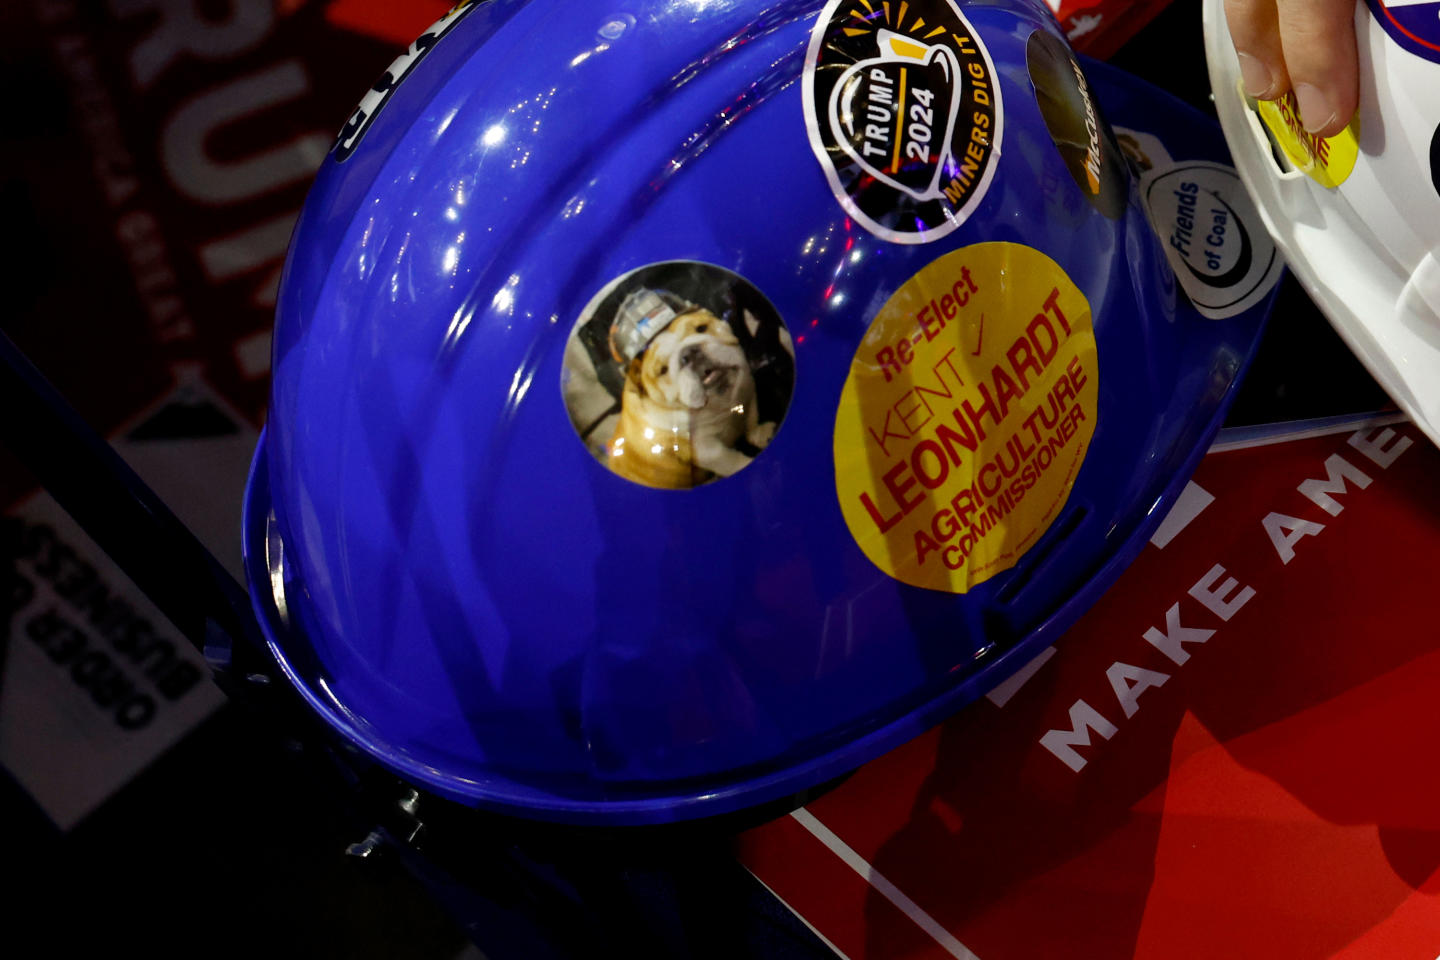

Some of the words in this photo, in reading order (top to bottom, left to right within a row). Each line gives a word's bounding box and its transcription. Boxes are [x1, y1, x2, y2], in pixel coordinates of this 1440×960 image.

[952, 33, 977, 55] IT
[968, 61, 991, 107] DIG
[863, 68, 895, 158] TRUMP
[906, 86, 935, 164] 2024
[944, 111, 991, 206] MINERS
[1169, 181, 1198, 258] Friends
[1206, 208, 1228, 247] Coal
[1206, 251, 1222, 271] of
[876, 266, 979, 382] Re-Elect
[859, 287, 1072, 534] LEONHARDT
[869, 346, 965, 458] KENT
[912, 354, 1088, 566] AGRICULTURE
[941, 402, 1086, 571] COMMISSIONER
[1038, 562, 1258, 775] MAKE
[1260, 425, 1415, 566] AME
